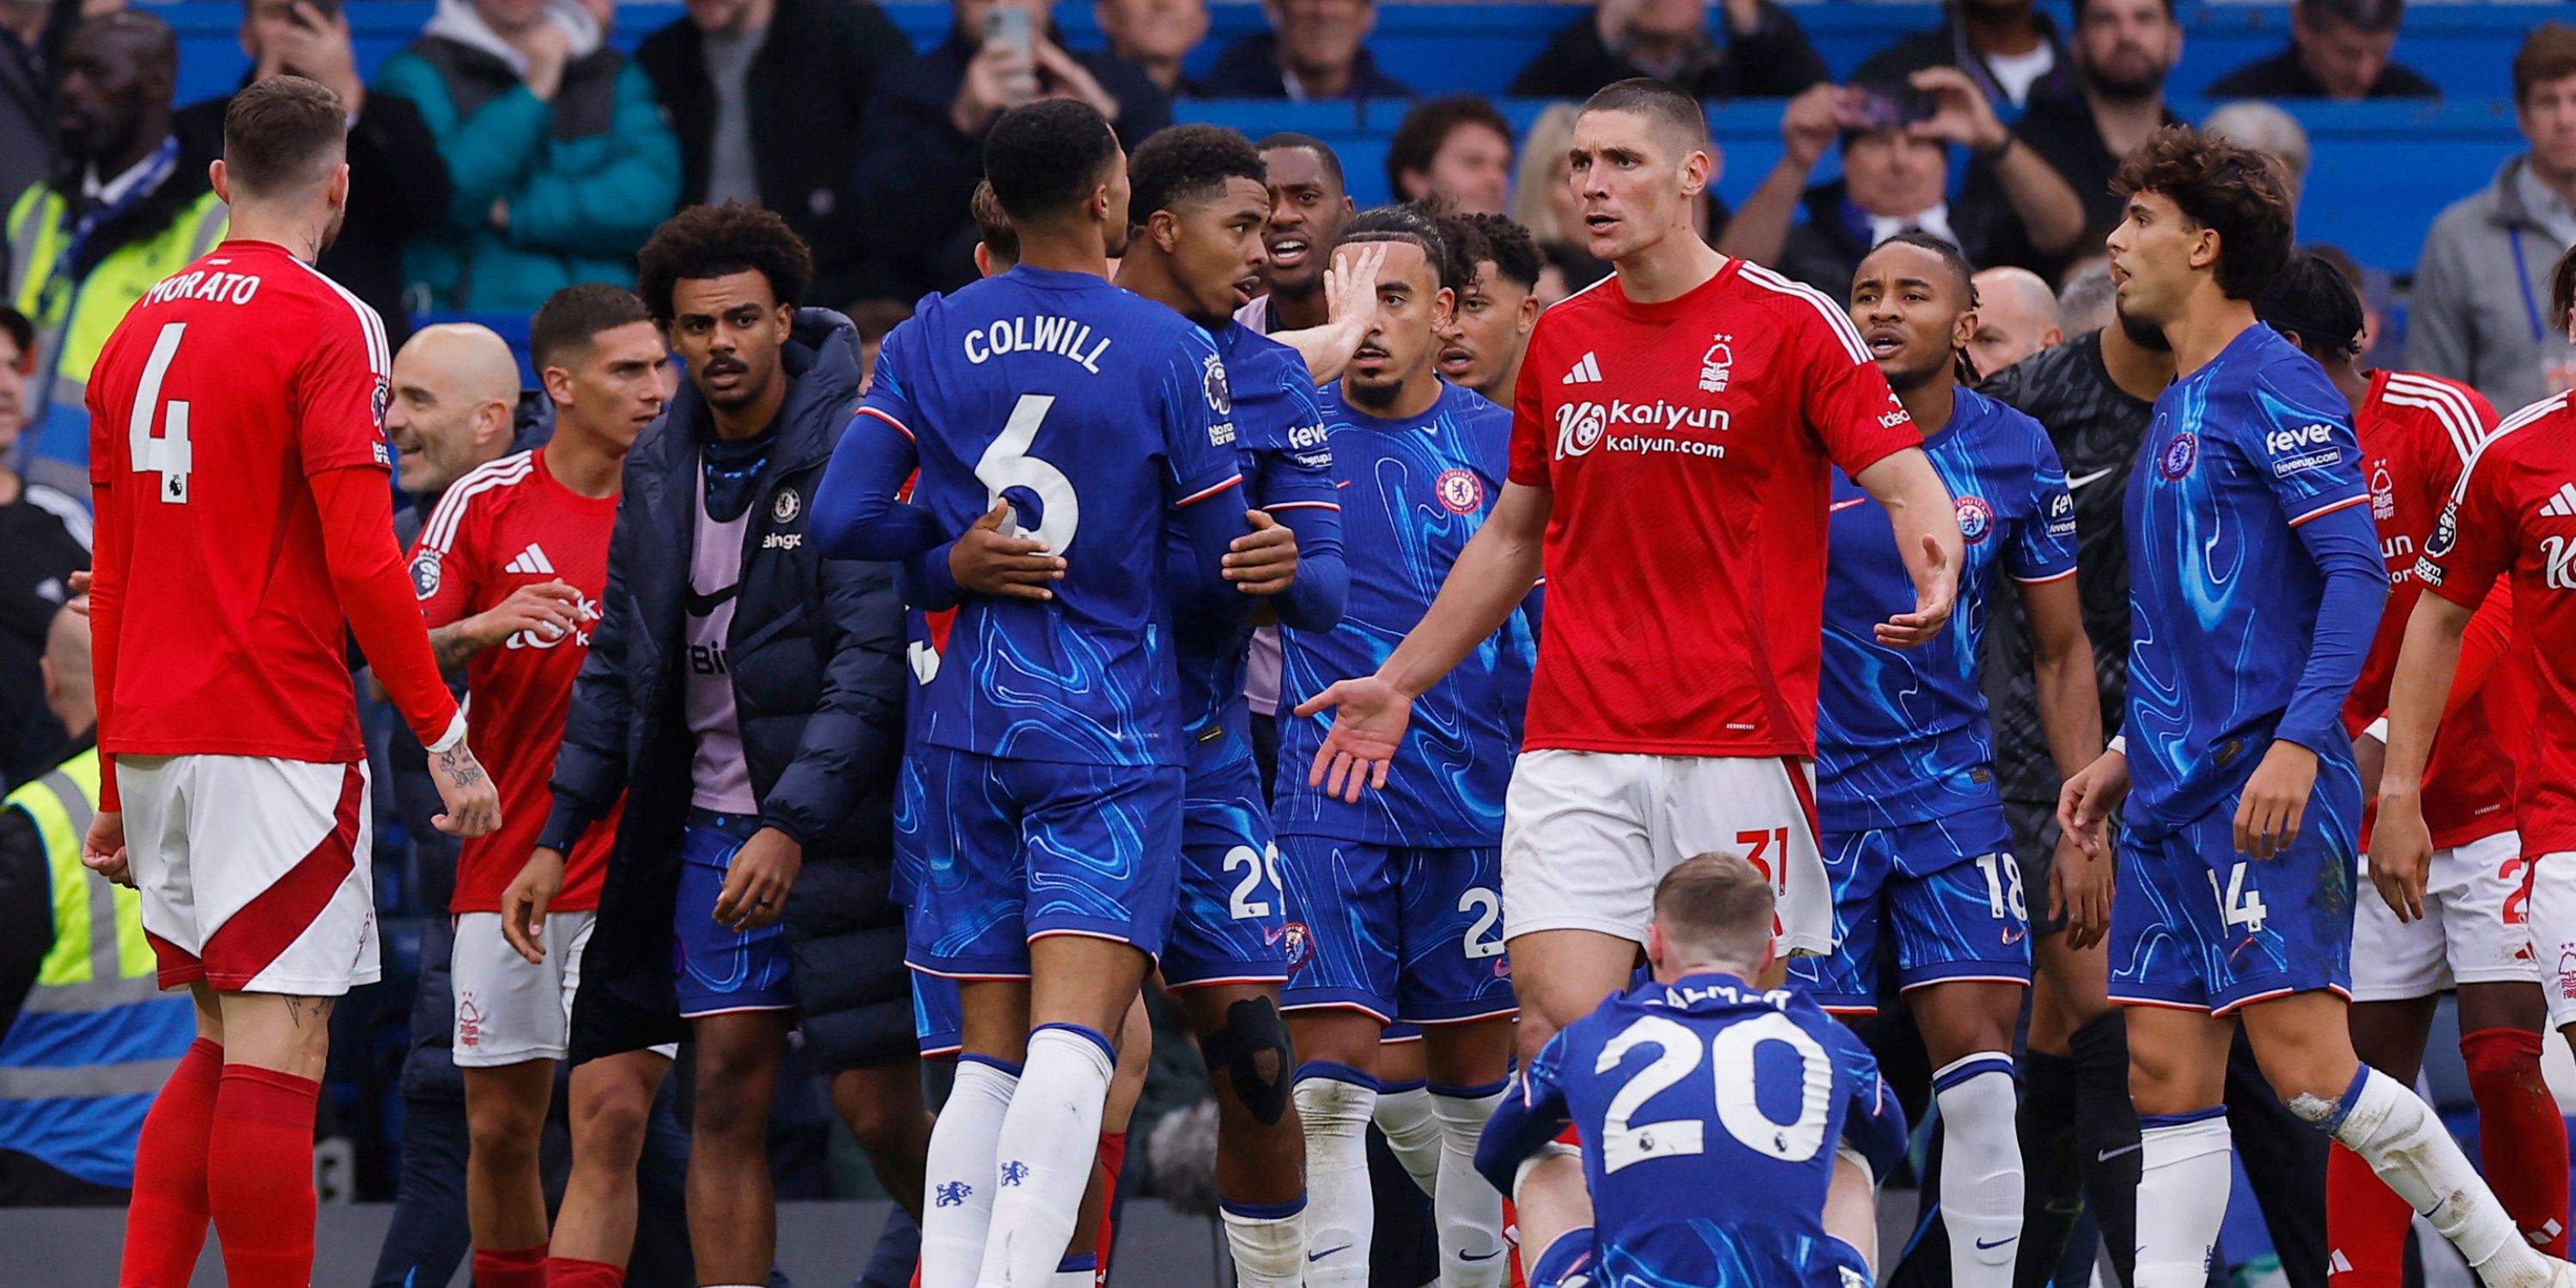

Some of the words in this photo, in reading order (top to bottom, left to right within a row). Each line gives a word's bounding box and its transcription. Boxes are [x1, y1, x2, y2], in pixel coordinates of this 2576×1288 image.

[143, 270, 261, 307] MORATO
[963, 315, 1112, 374] COLWILL
[129, 322, 192, 505] 4
[1607, 434, 1726, 459] kaiyun.com
[2267, 423, 2332, 455] fever
[974, 393, 1079, 557] 6
[2276, 452, 2338, 474] feverup.com
[1736, 827, 1789, 896] 31
[1976, 852, 2028, 921] 18
[2206, 861, 2267, 939] 14
[1594, 1012, 1833, 1176] 20
